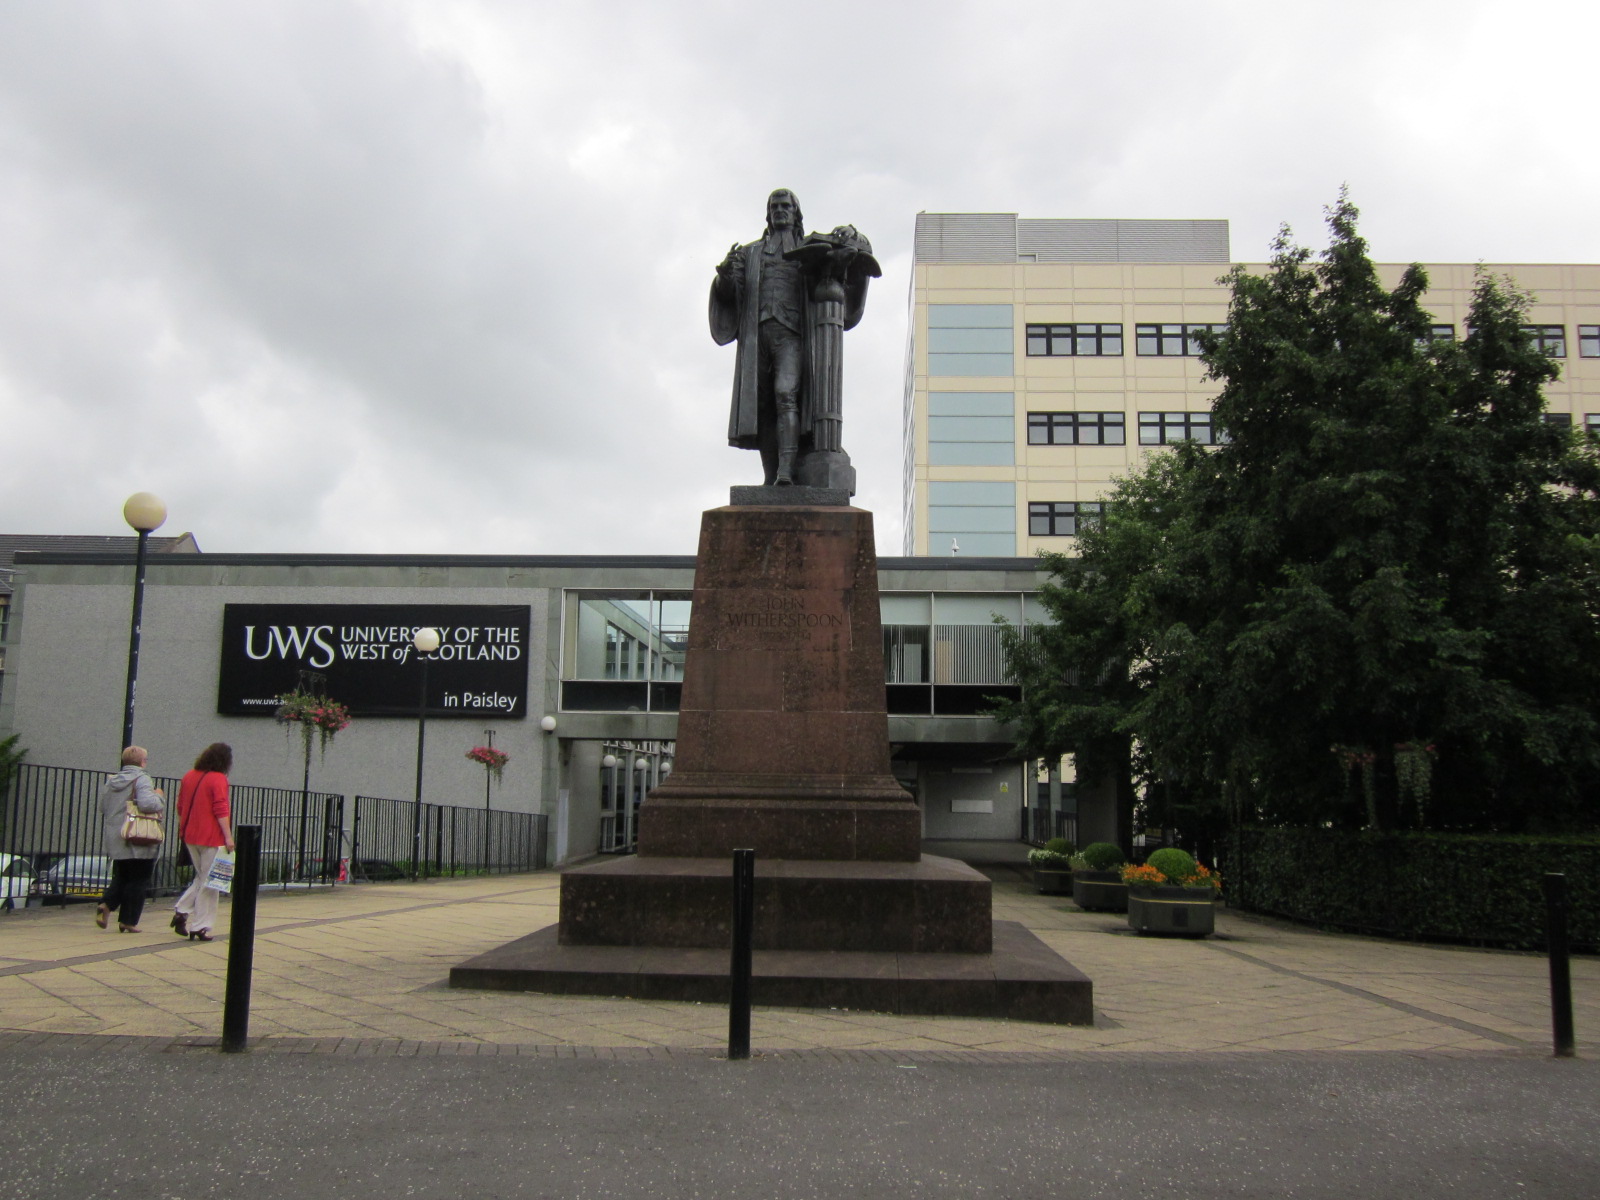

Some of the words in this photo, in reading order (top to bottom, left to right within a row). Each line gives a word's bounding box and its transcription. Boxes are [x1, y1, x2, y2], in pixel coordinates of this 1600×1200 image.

[766, 598, 805, 611] JOHN
[727, 613, 843, 627] WITHERSPOON
[340, 626, 451, 643] UNIVERSY
[454, 626, 480, 643] OF
[484, 627, 520, 643] THE
[245, 625, 335, 668] UWS
[340, 643, 390, 660] WEST
[392, 644, 413, 665] of
[416, 644, 521, 661] OTLAND
[443, 692, 458, 707] in
[463, 692, 518, 712] Paisley
